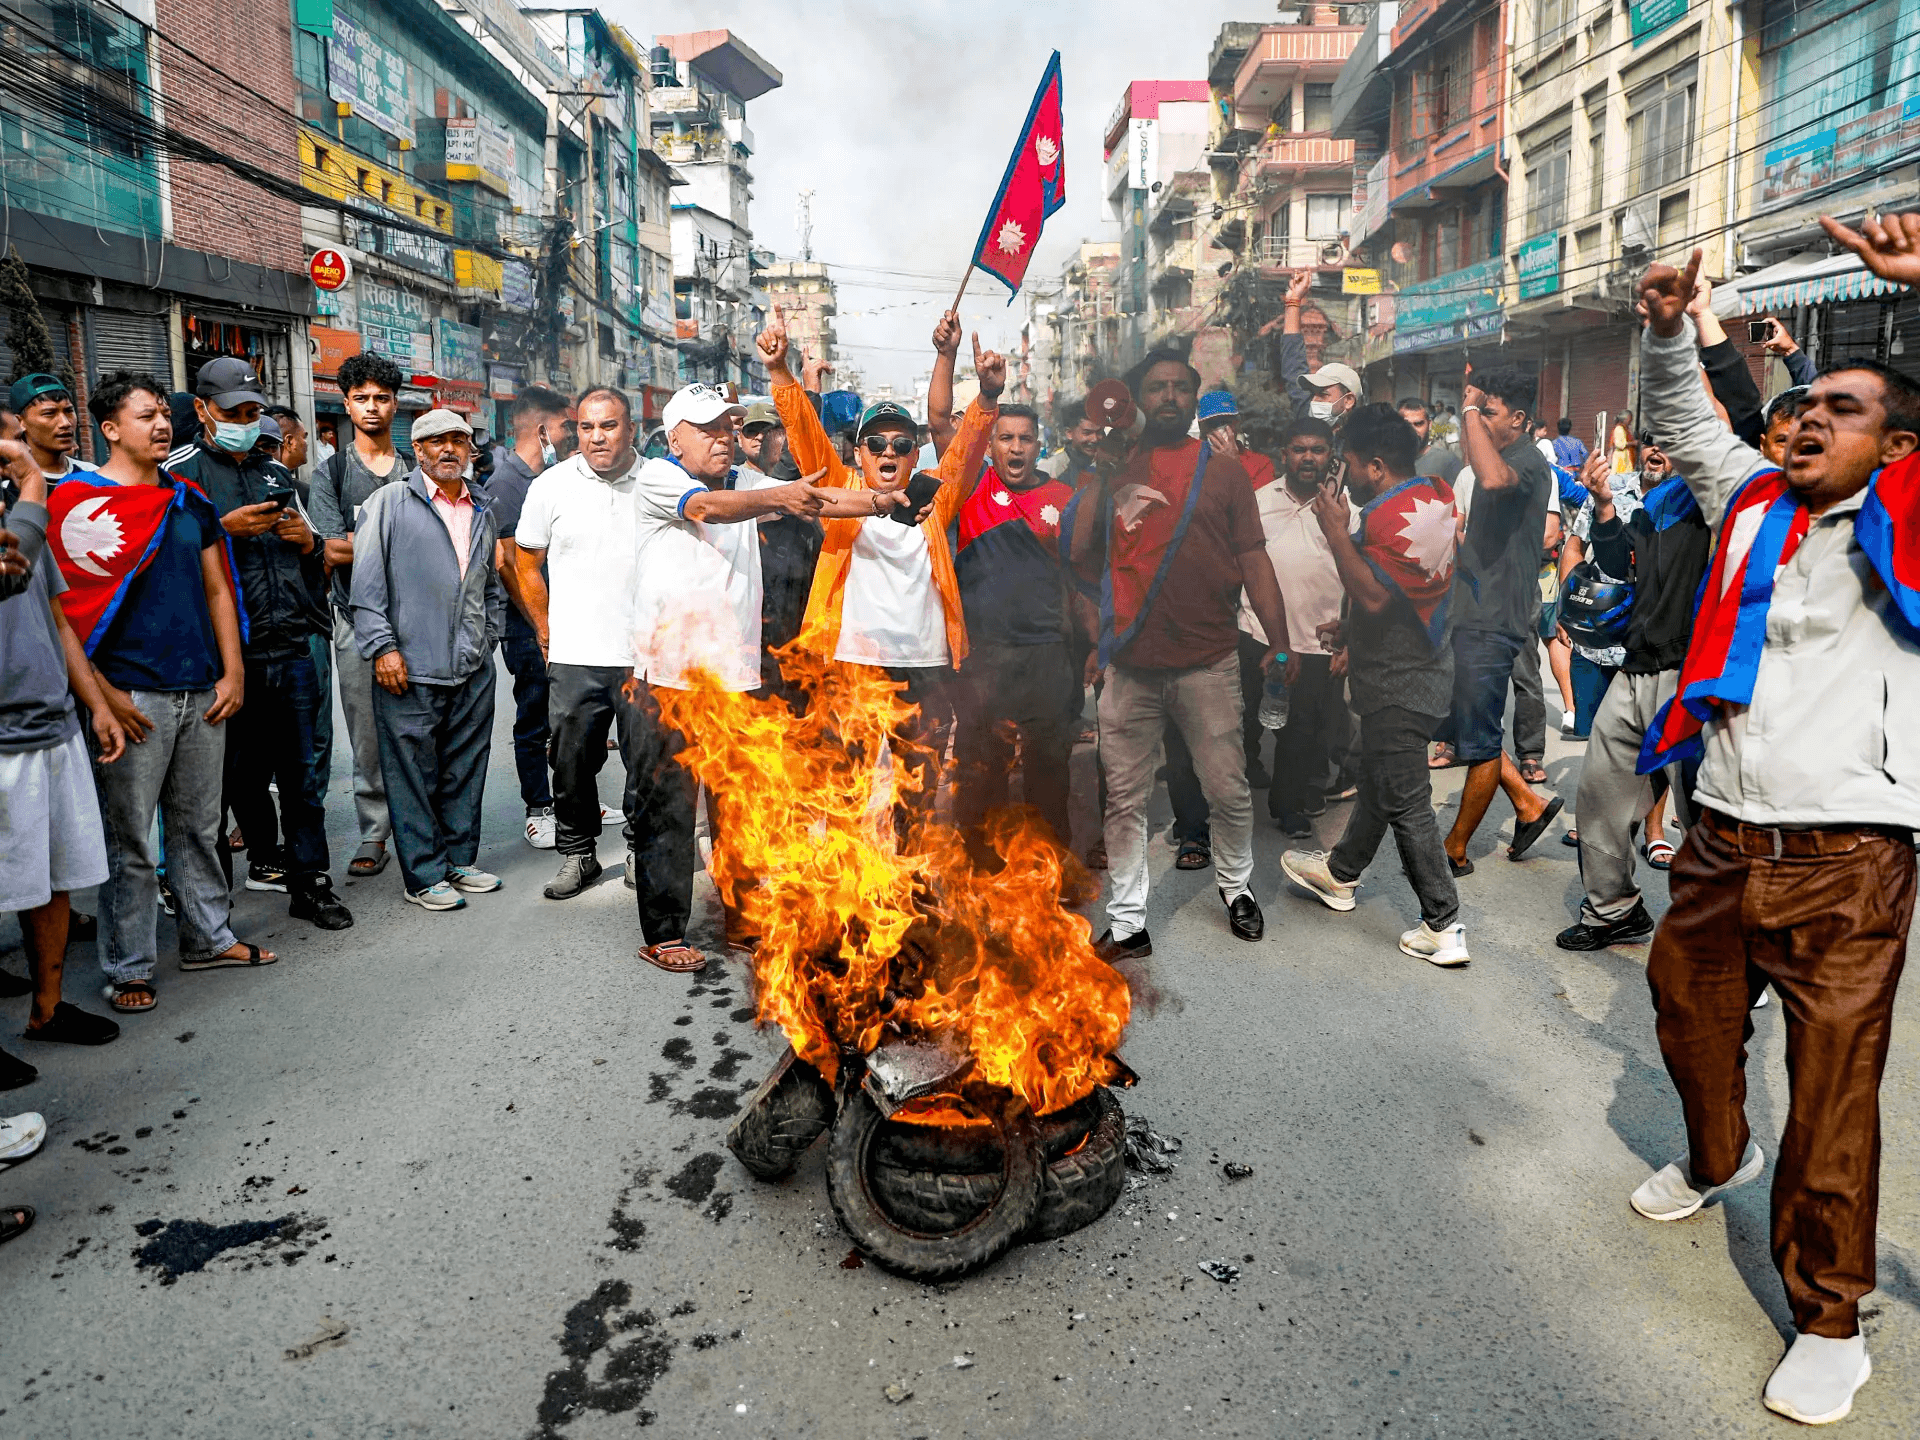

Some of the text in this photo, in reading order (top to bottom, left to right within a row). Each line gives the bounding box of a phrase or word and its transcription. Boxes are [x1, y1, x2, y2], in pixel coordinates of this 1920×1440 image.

[464, 129, 475, 138] PTE
[464, 153, 475, 162] SAT
[1139, 131, 1149, 188] COMPLEX
[313, 265, 341, 277] BAJEKO
